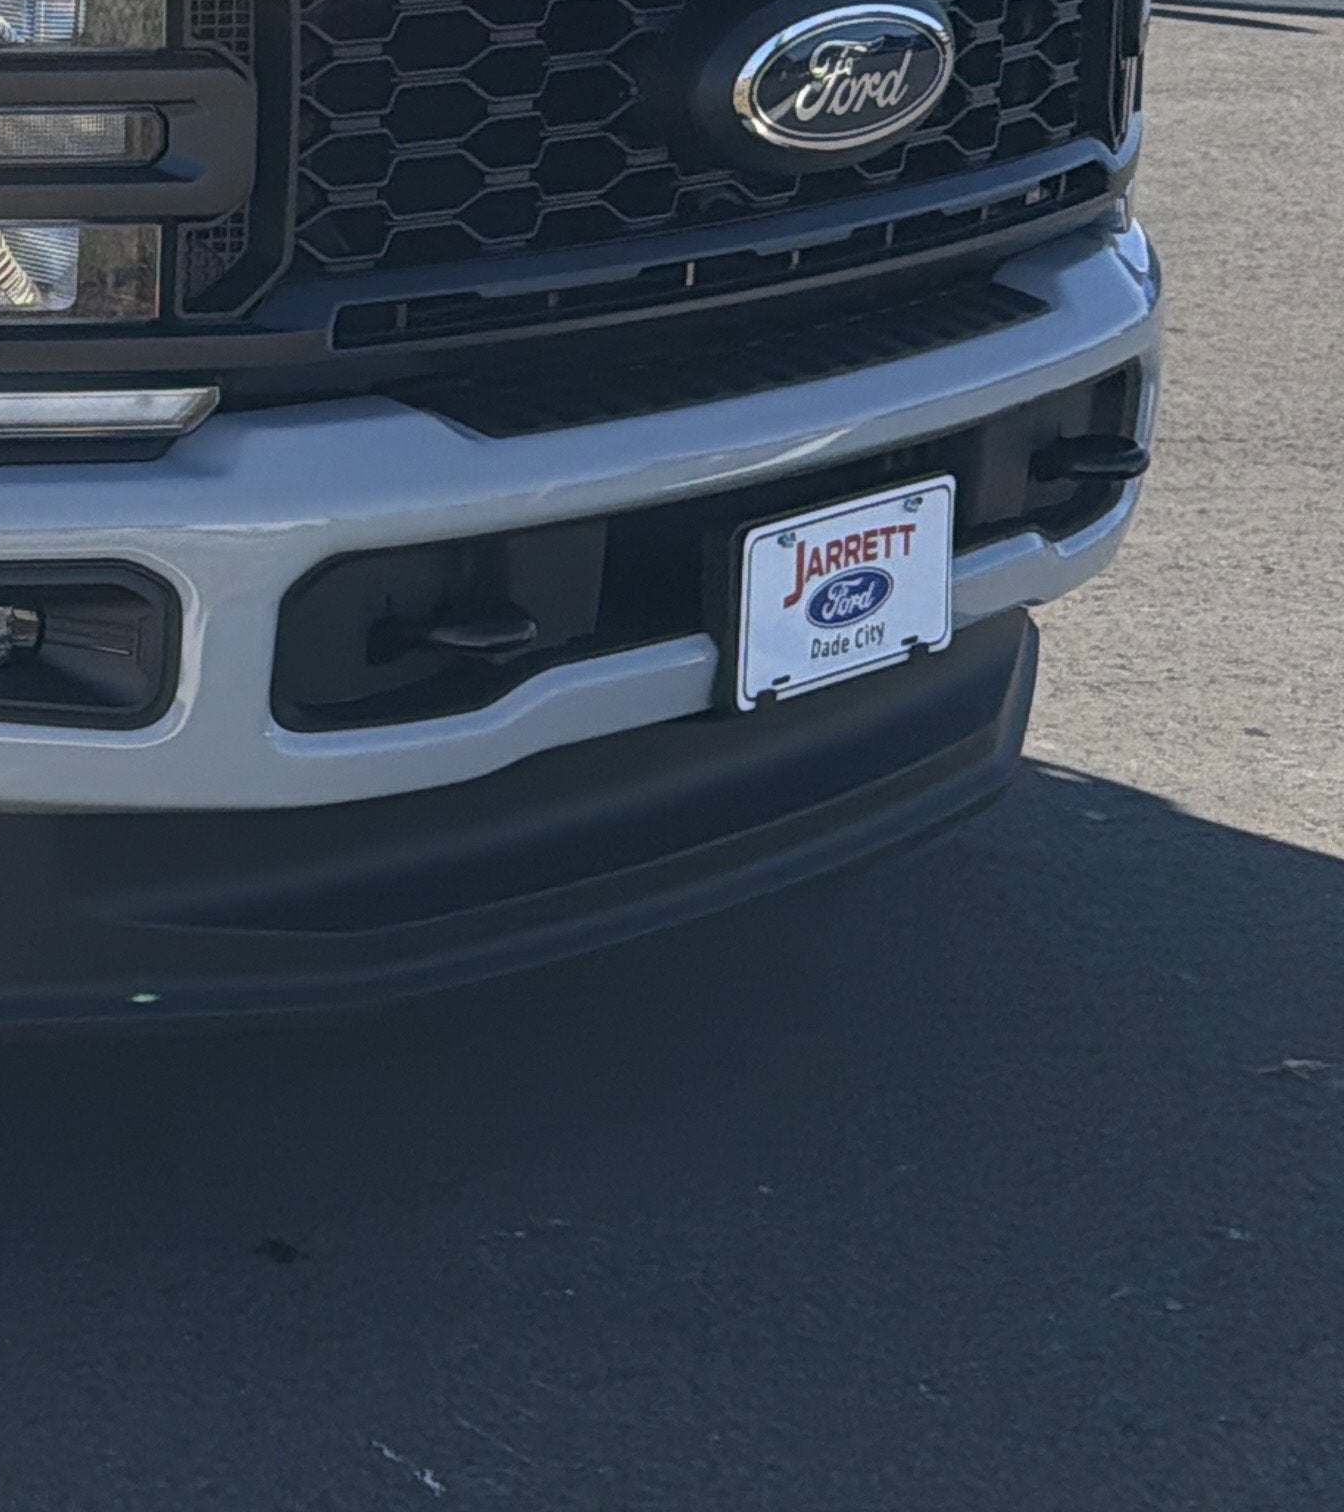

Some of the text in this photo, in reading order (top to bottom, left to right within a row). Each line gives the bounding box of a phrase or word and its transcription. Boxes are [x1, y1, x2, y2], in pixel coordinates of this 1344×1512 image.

[794, 36, 913, 122] Ford
[783, 523, 917, 610] JARRETT
[821, 576, 876, 621] Ford
[810, 621, 886, 660] Dade City
